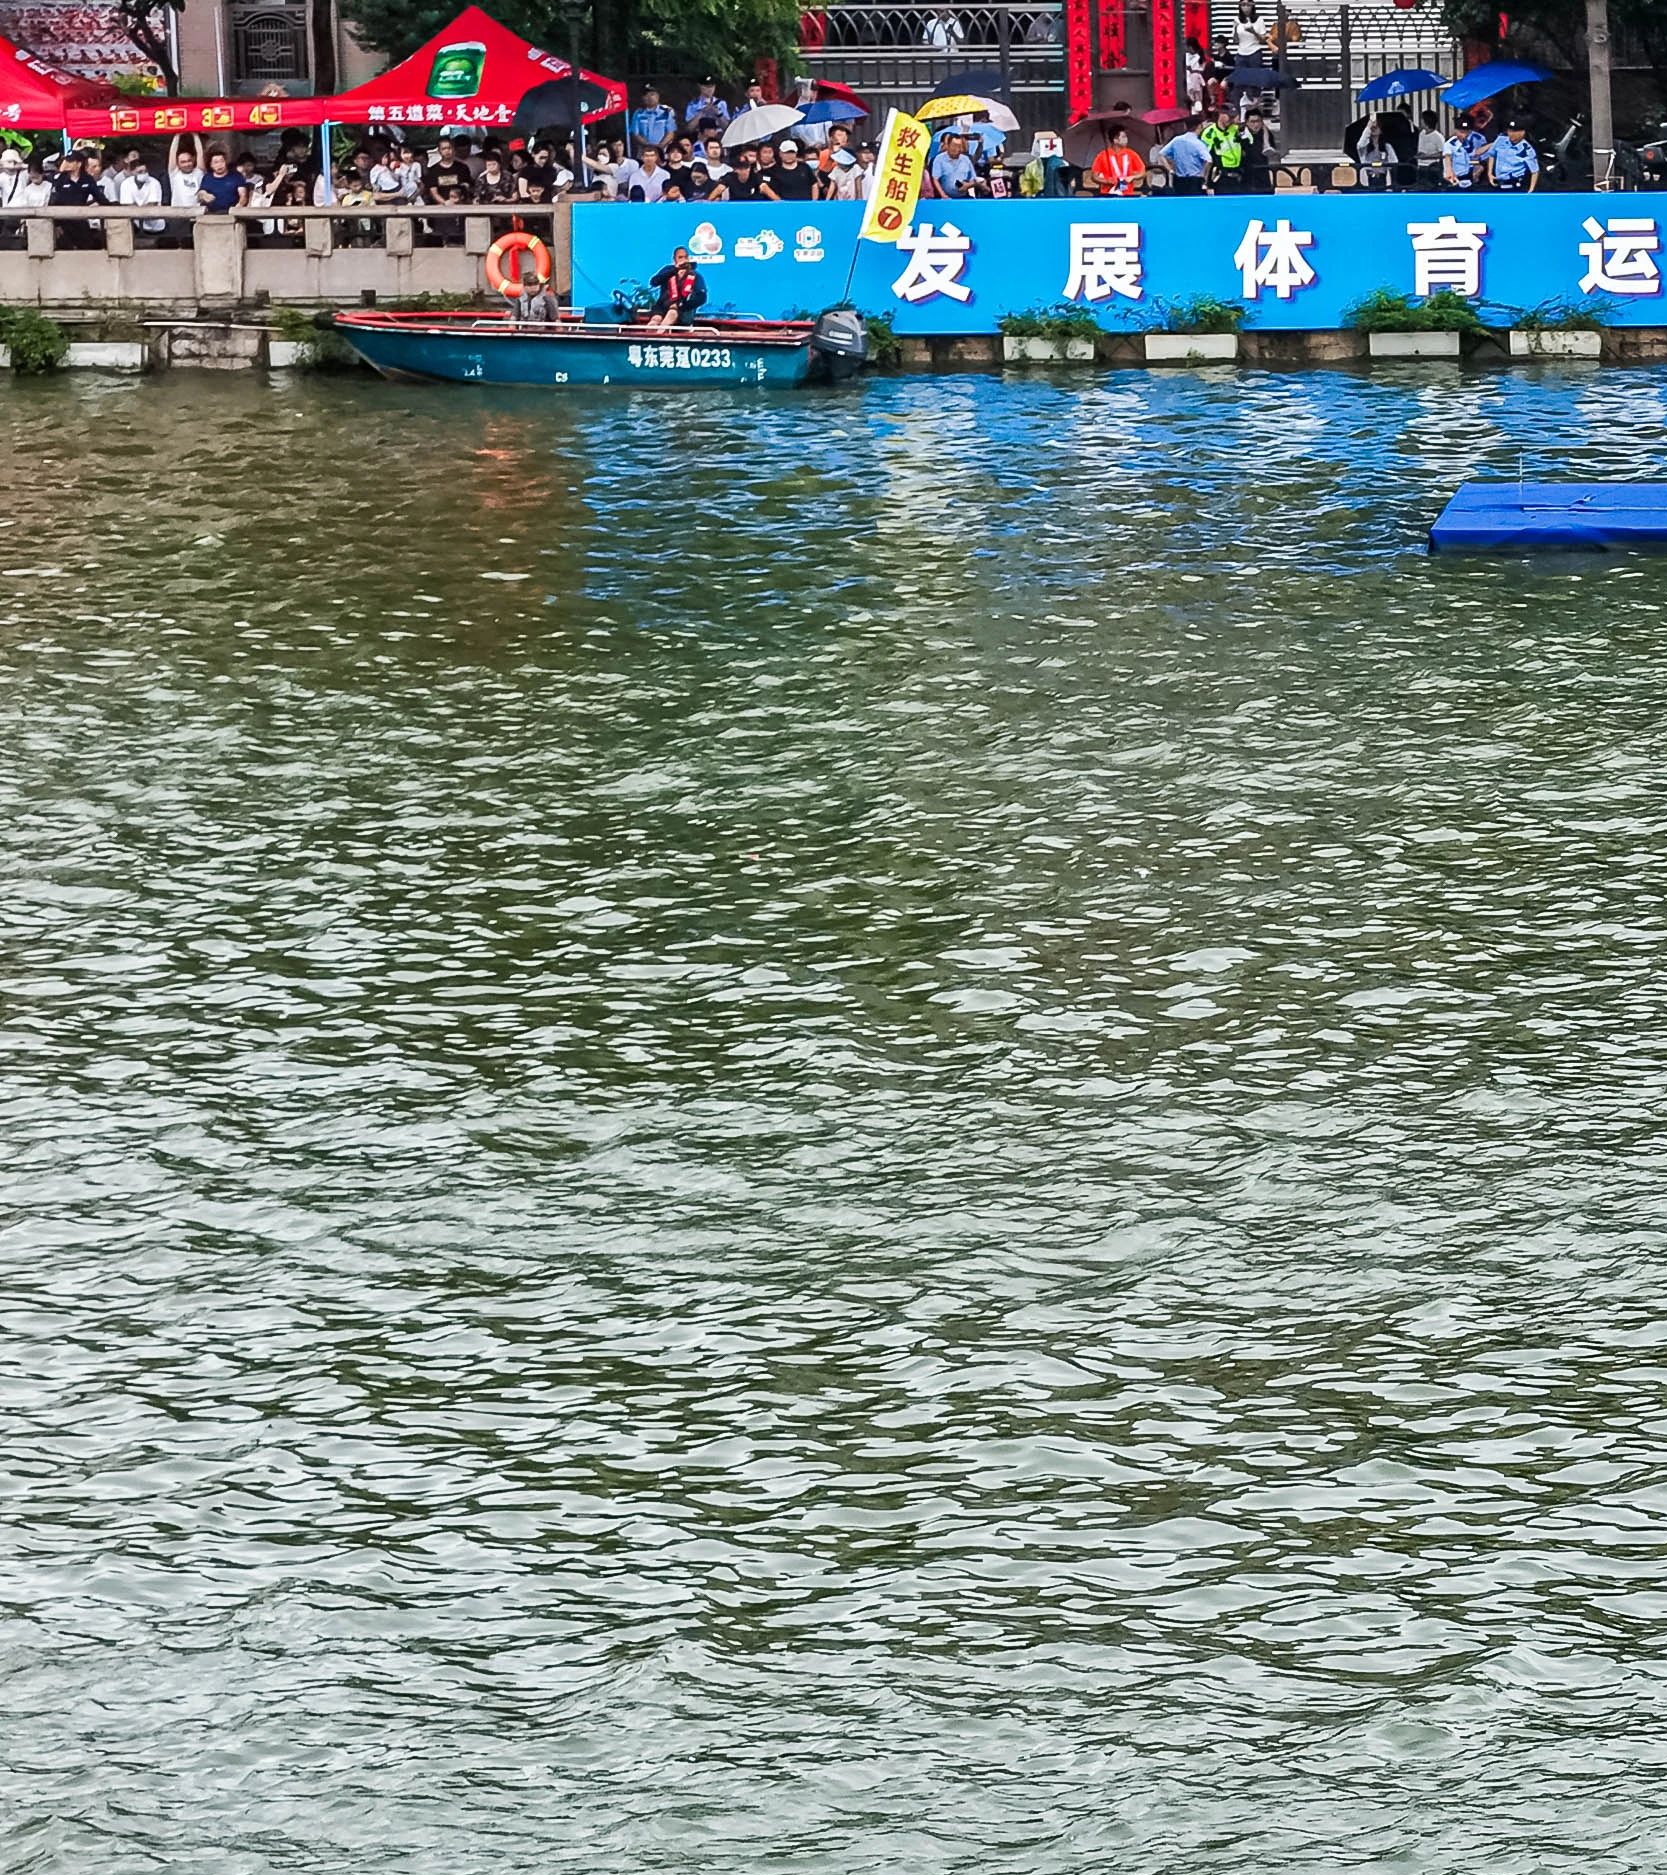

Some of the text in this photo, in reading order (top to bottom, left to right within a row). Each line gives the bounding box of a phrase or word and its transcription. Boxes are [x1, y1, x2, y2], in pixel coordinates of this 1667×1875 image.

[109, 112, 118, 131] 1
[154, 111, 165, 129] 2
[201, 109, 212, 127] 3
[249, 107, 259, 124] 4
[885, 126, 921, 203] 救生船
